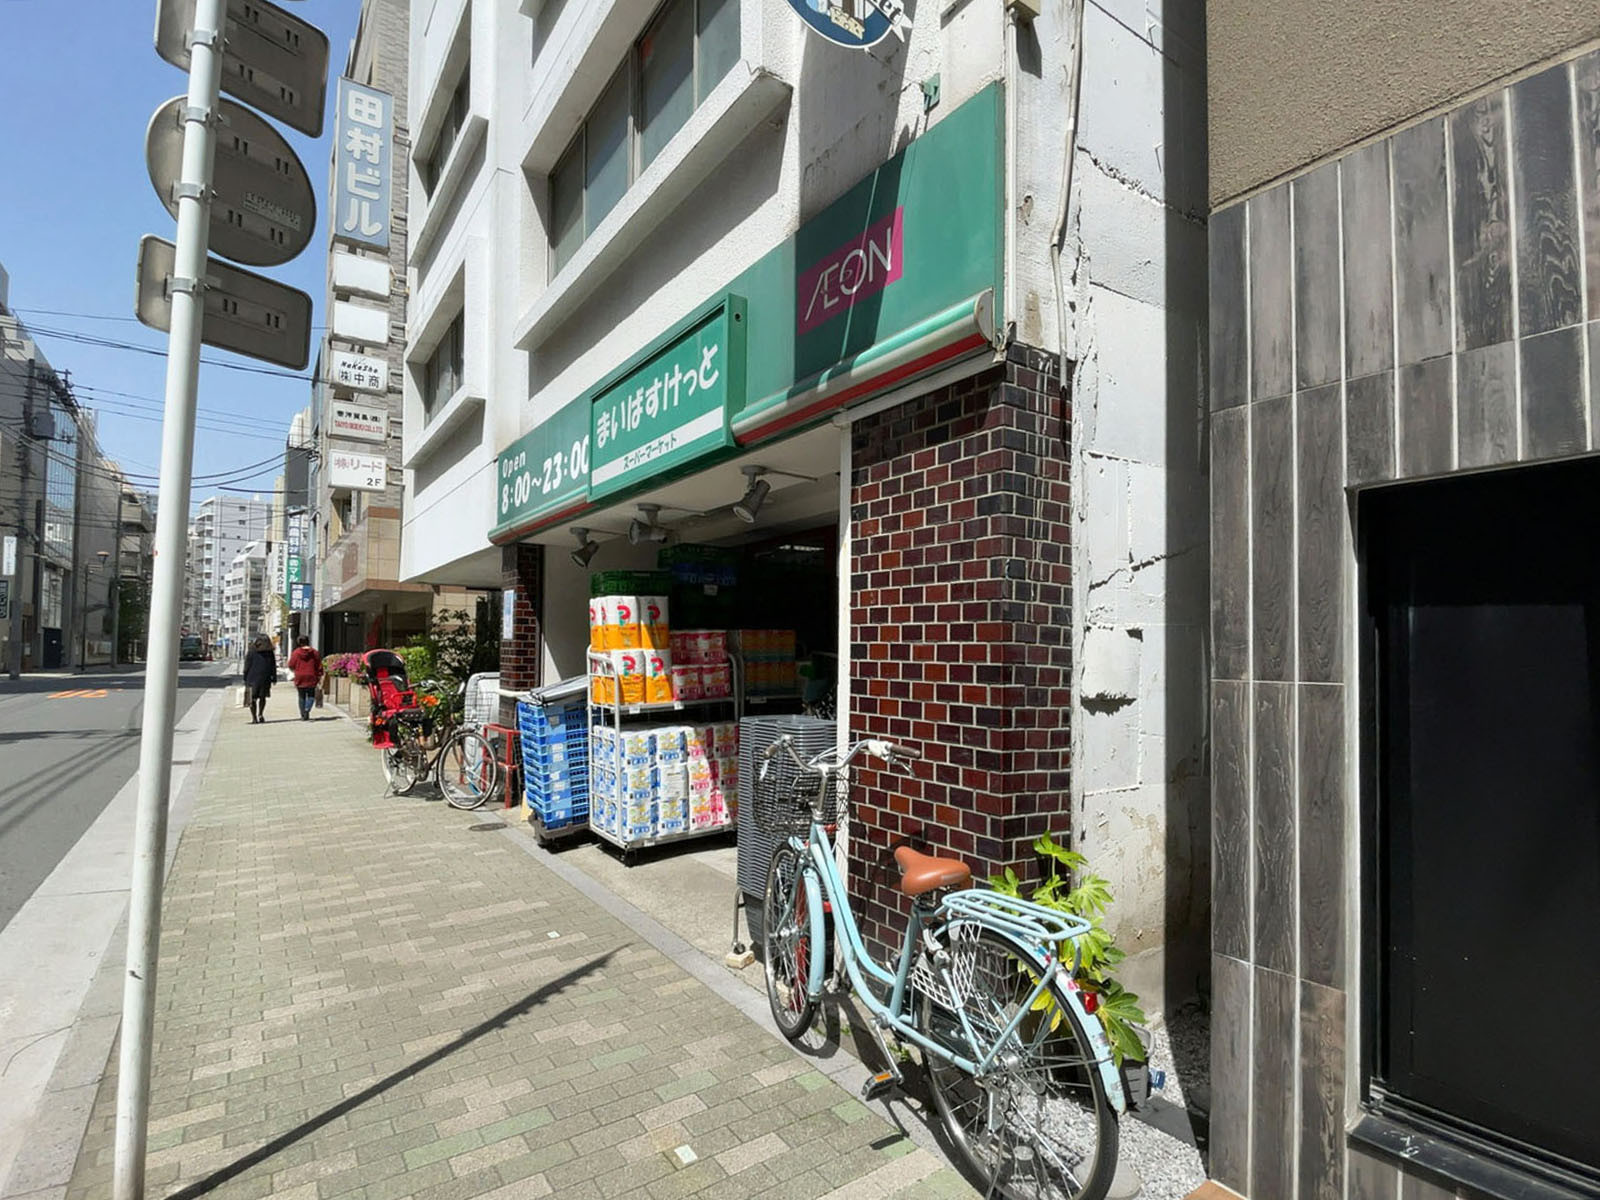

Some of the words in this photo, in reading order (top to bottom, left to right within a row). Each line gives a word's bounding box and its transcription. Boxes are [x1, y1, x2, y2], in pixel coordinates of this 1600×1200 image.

[345, 90, 383, 237] 田村ビル
[597, 344, 719, 448] まいばすけっと
[502, 451, 526, 477] Open
[623, 435, 677, 470] スーパーマーケット
[367, 478, 381, 486] 2F
